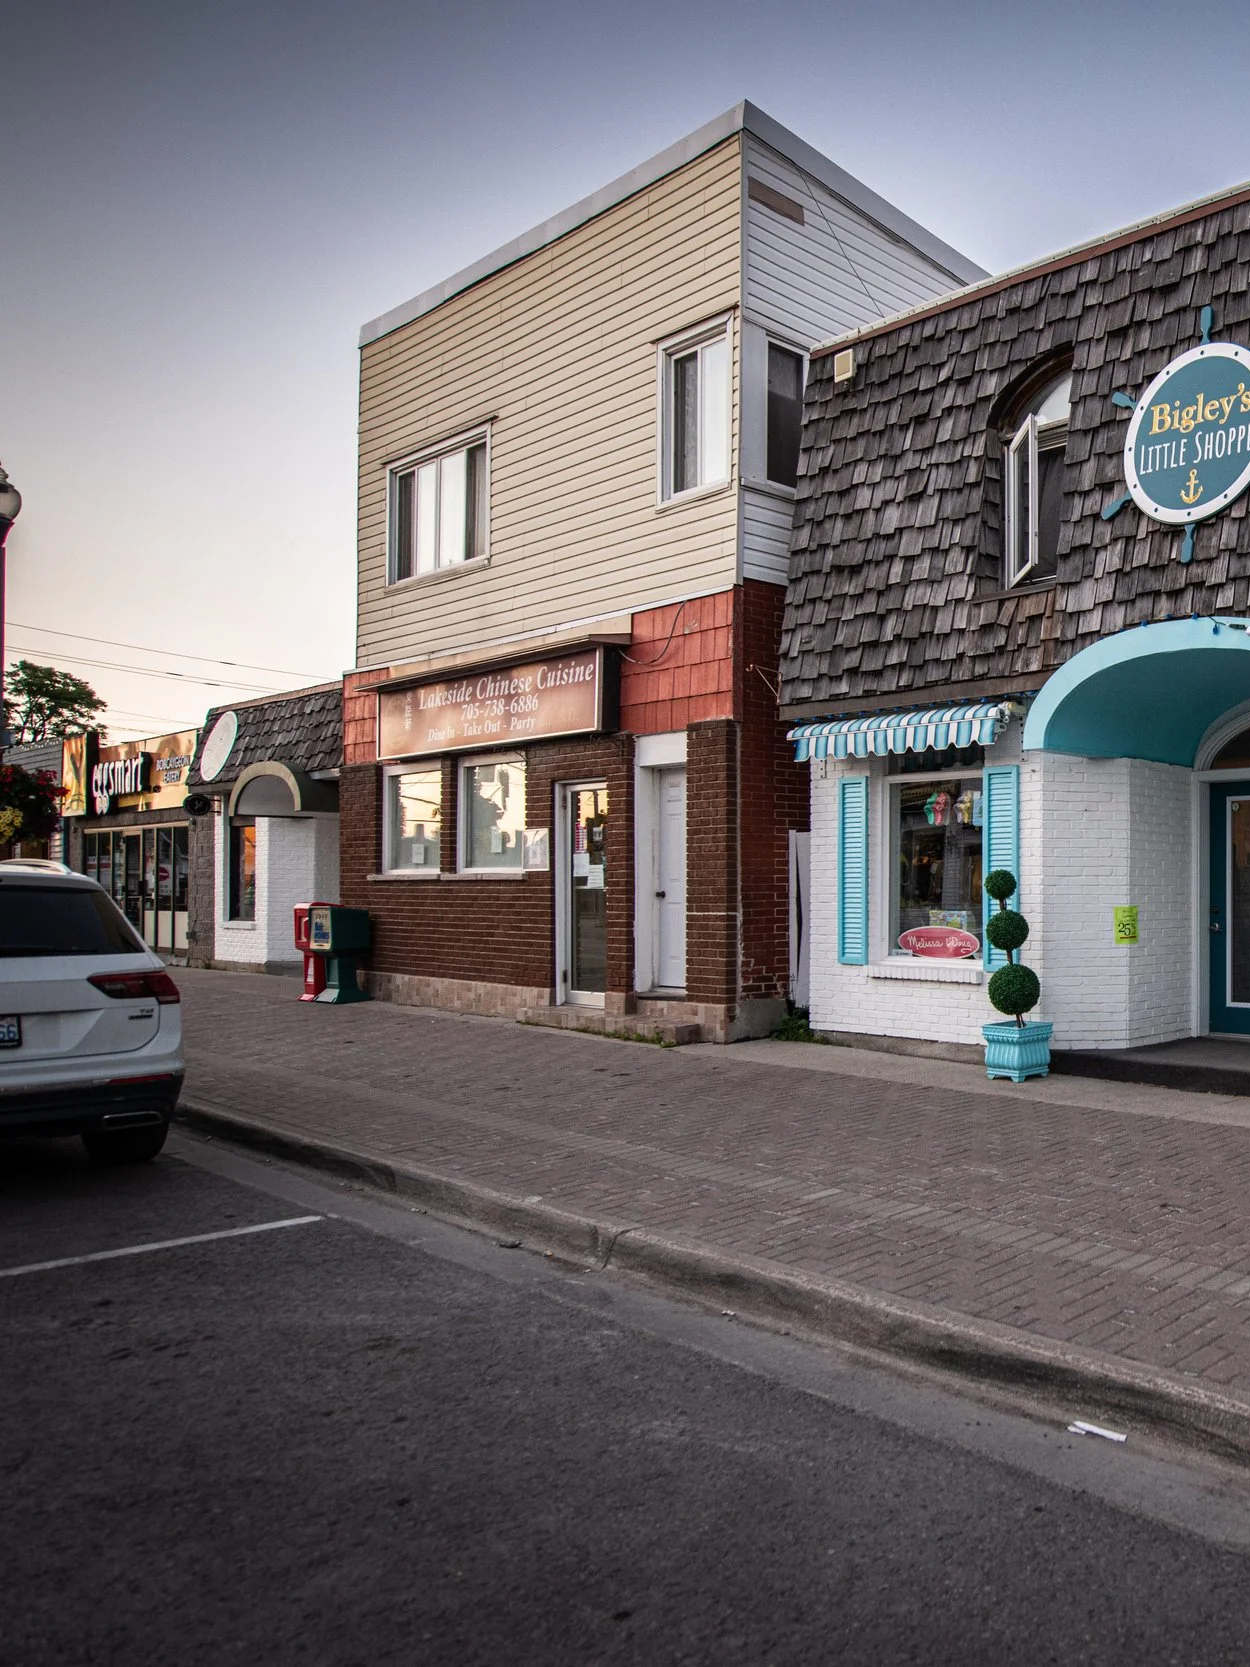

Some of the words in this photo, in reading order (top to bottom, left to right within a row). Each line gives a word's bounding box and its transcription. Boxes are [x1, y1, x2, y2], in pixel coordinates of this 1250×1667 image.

[1139, 438, 1188, 475] LITTLE
[418, 681, 473, 710] Lakeside
[476, 675, 532, 701] Chinese
[536, 661, 594, 690] Cuisine
[461, 693, 539, 721] 705-738-6886
[427, 728, 447, 743] Dine
[463, 722, 482, 737] Take
[484, 720, 501, 735] Out
[510, 716, 537, 733] Party
[93, 751, 144, 815] eggsmart
[907, 935, 943, 951] Melissa
[1118, 922, 1131, 936] 25
